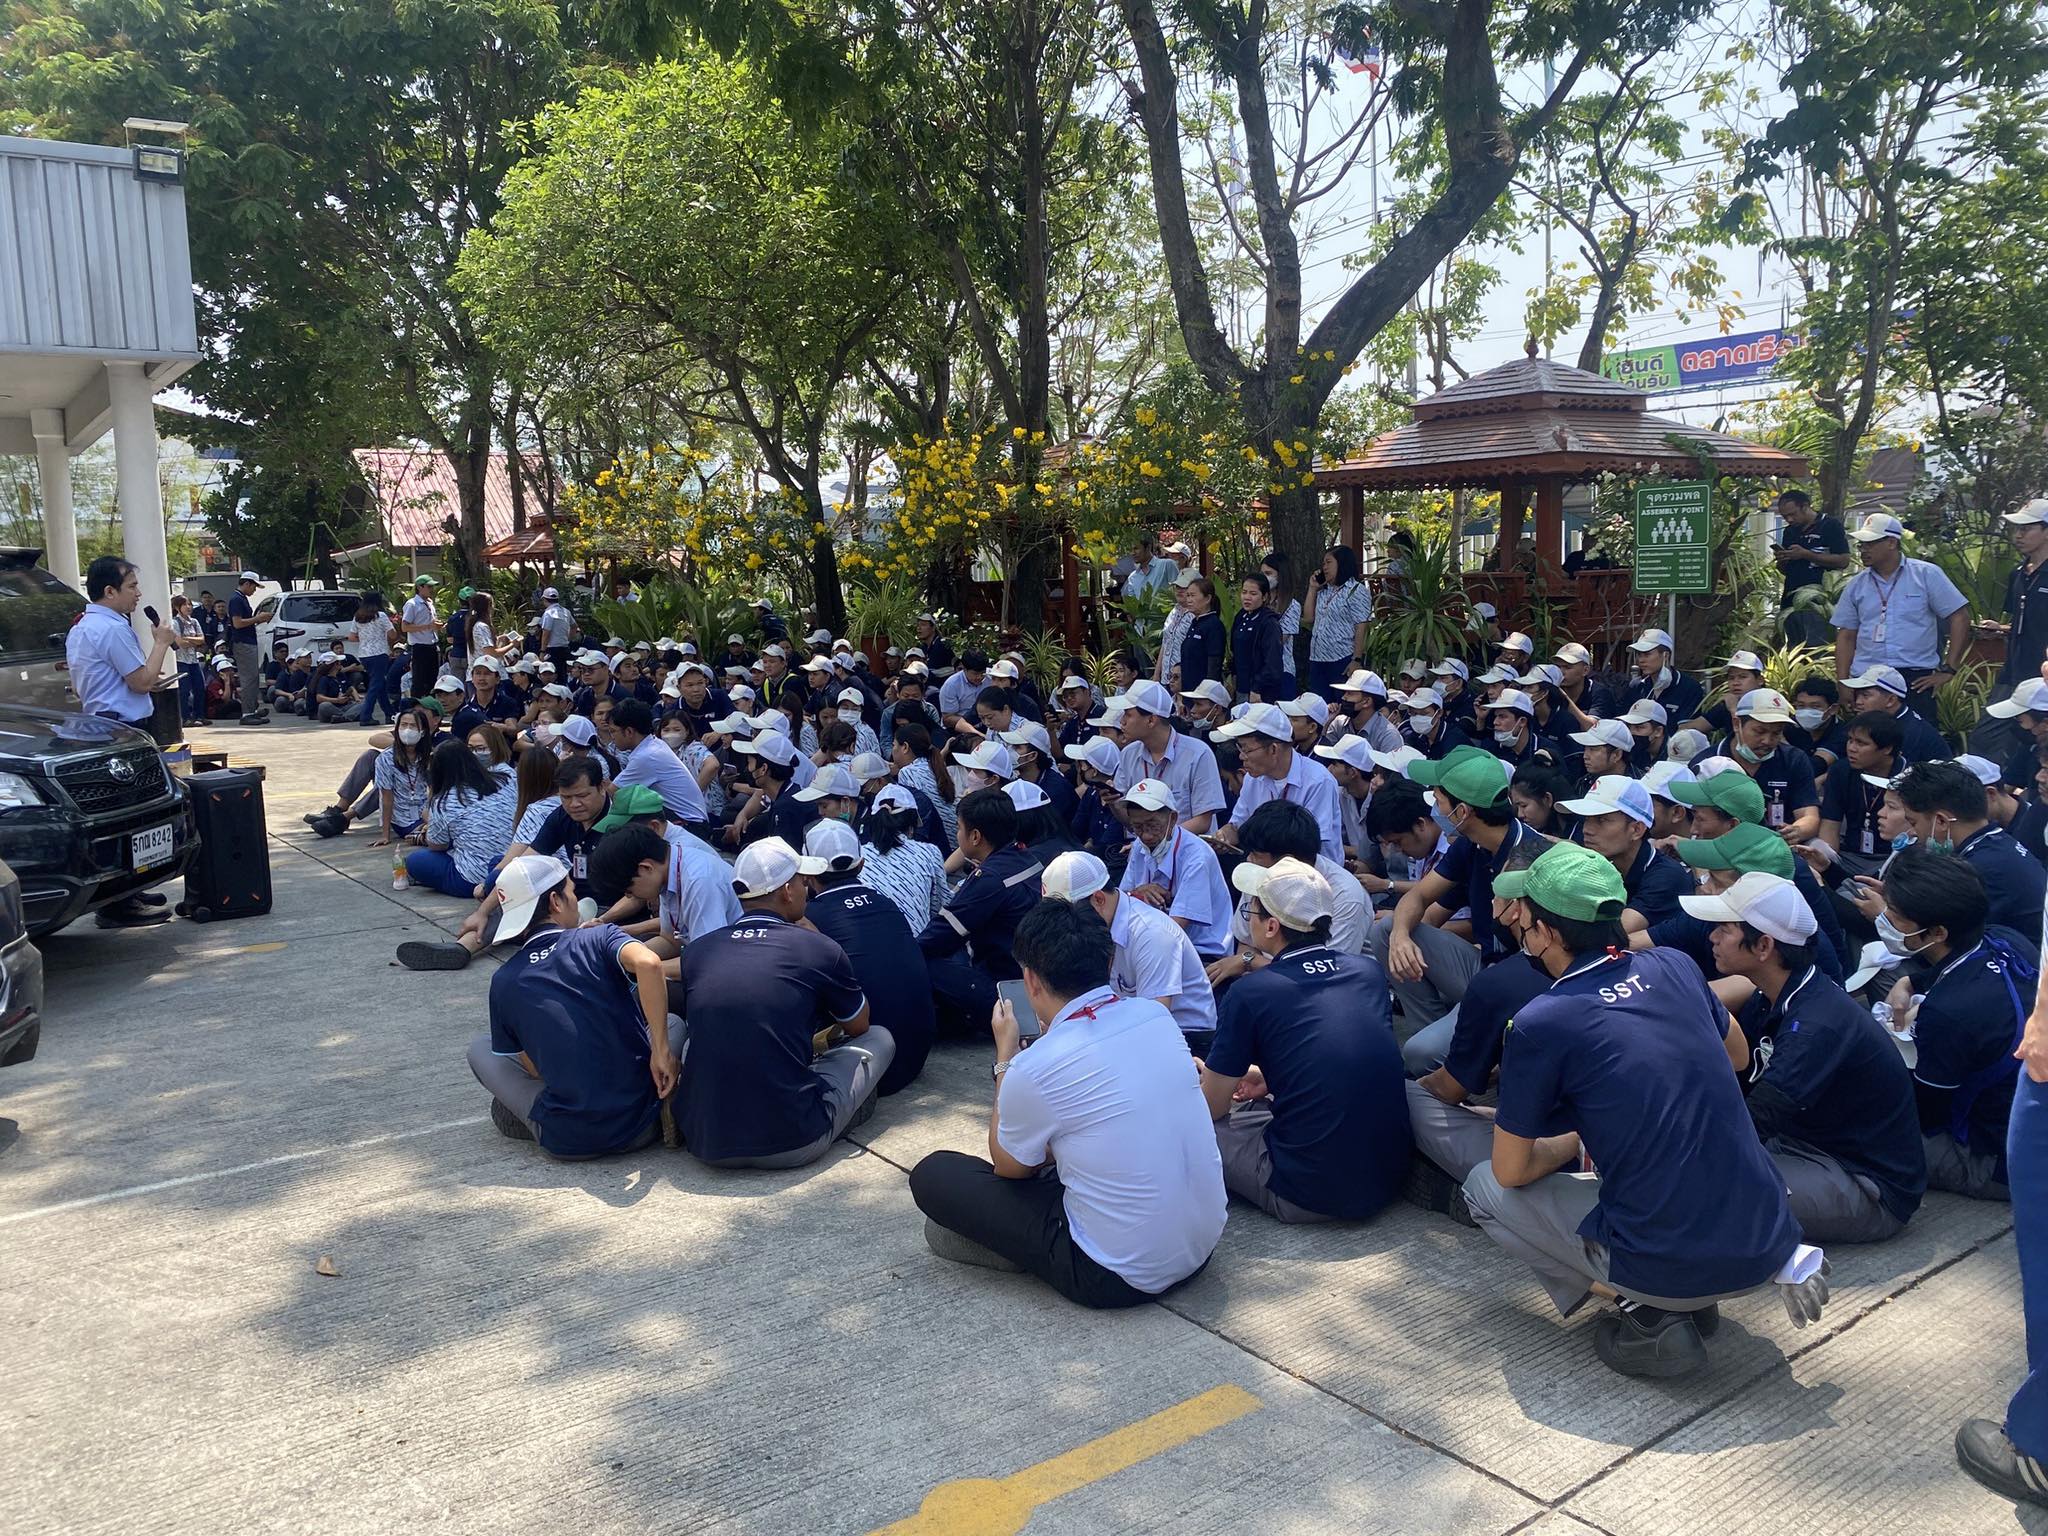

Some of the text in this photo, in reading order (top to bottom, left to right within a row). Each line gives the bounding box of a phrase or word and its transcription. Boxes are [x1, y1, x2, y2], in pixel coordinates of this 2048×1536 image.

[1646, 490, 1701, 506] จุดรวมพล
[1641, 506, 1705, 516] ASSEMBLY POINT
[151, 827, 172, 847] 8242
[844, 894, 873, 909] SST.
[731, 928, 768, 939] SST.
[529, 942, 558, 964] SST.
[1302, 959, 1340, 974] SST.
[1598, 974, 1652, 1003] SST.
